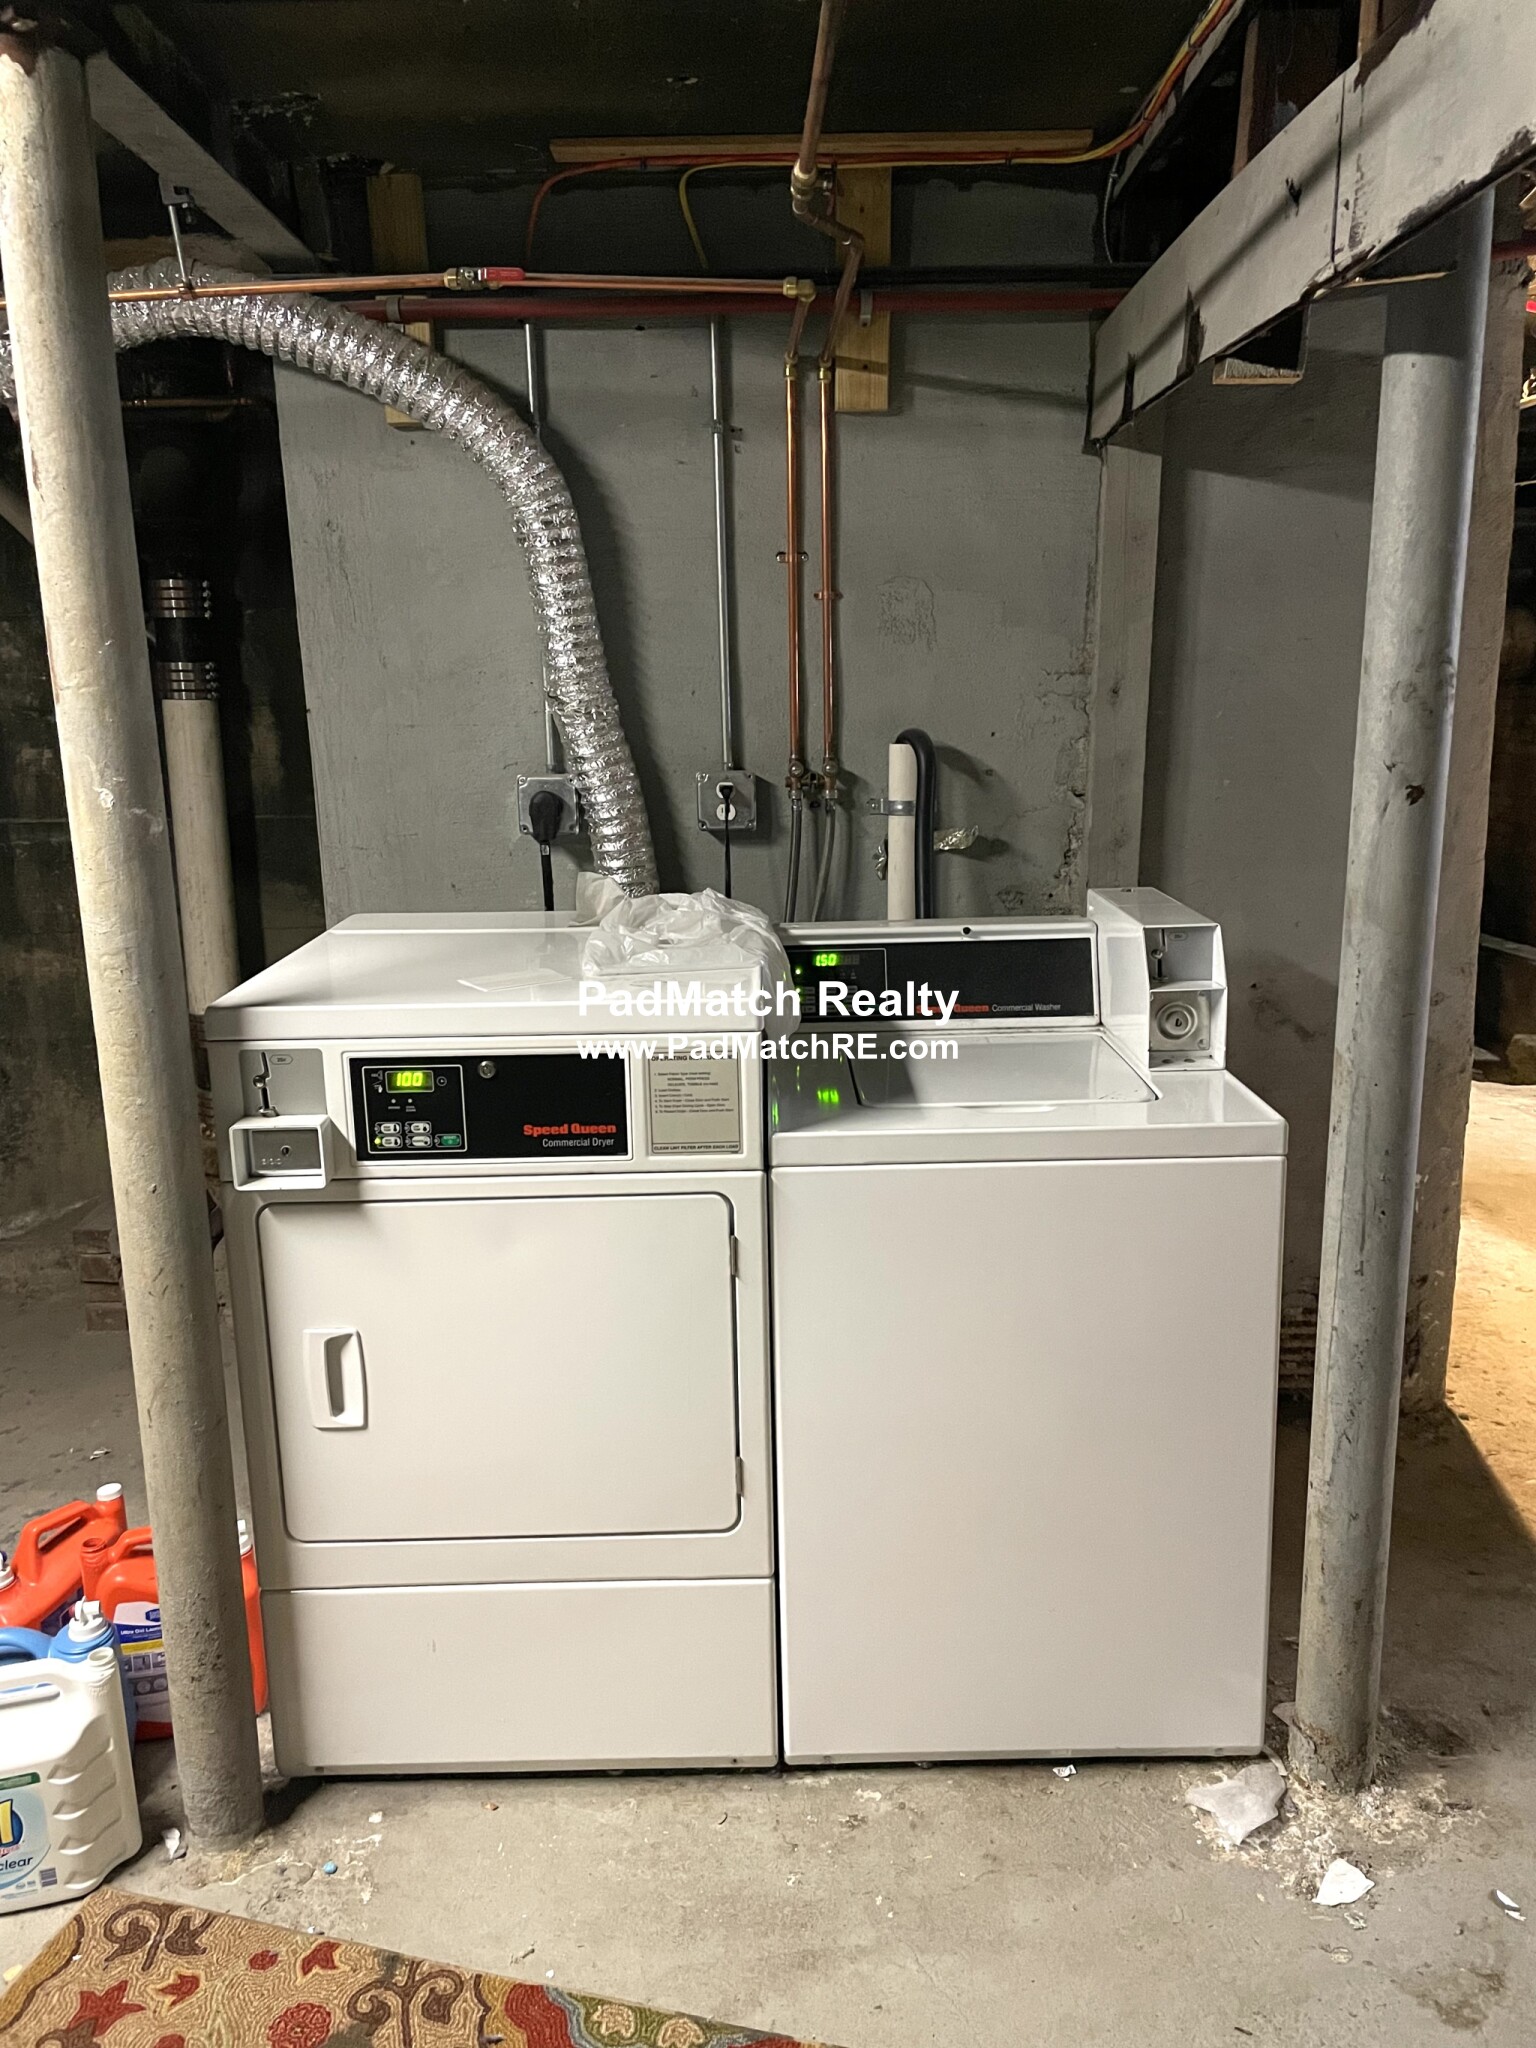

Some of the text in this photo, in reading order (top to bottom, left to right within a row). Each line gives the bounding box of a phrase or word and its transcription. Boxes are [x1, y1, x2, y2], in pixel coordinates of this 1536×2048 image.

[991, 1003, 1034, 1012] Commercial
[1035, 1003, 1062, 1011] Washer
[396, 1072, 424, 1087] 100
[523, 1122, 617, 1138] Speed Queen
[542, 1137, 615, 1148] Commercial Dryer
[0, 1856, 34, 1871] clear
